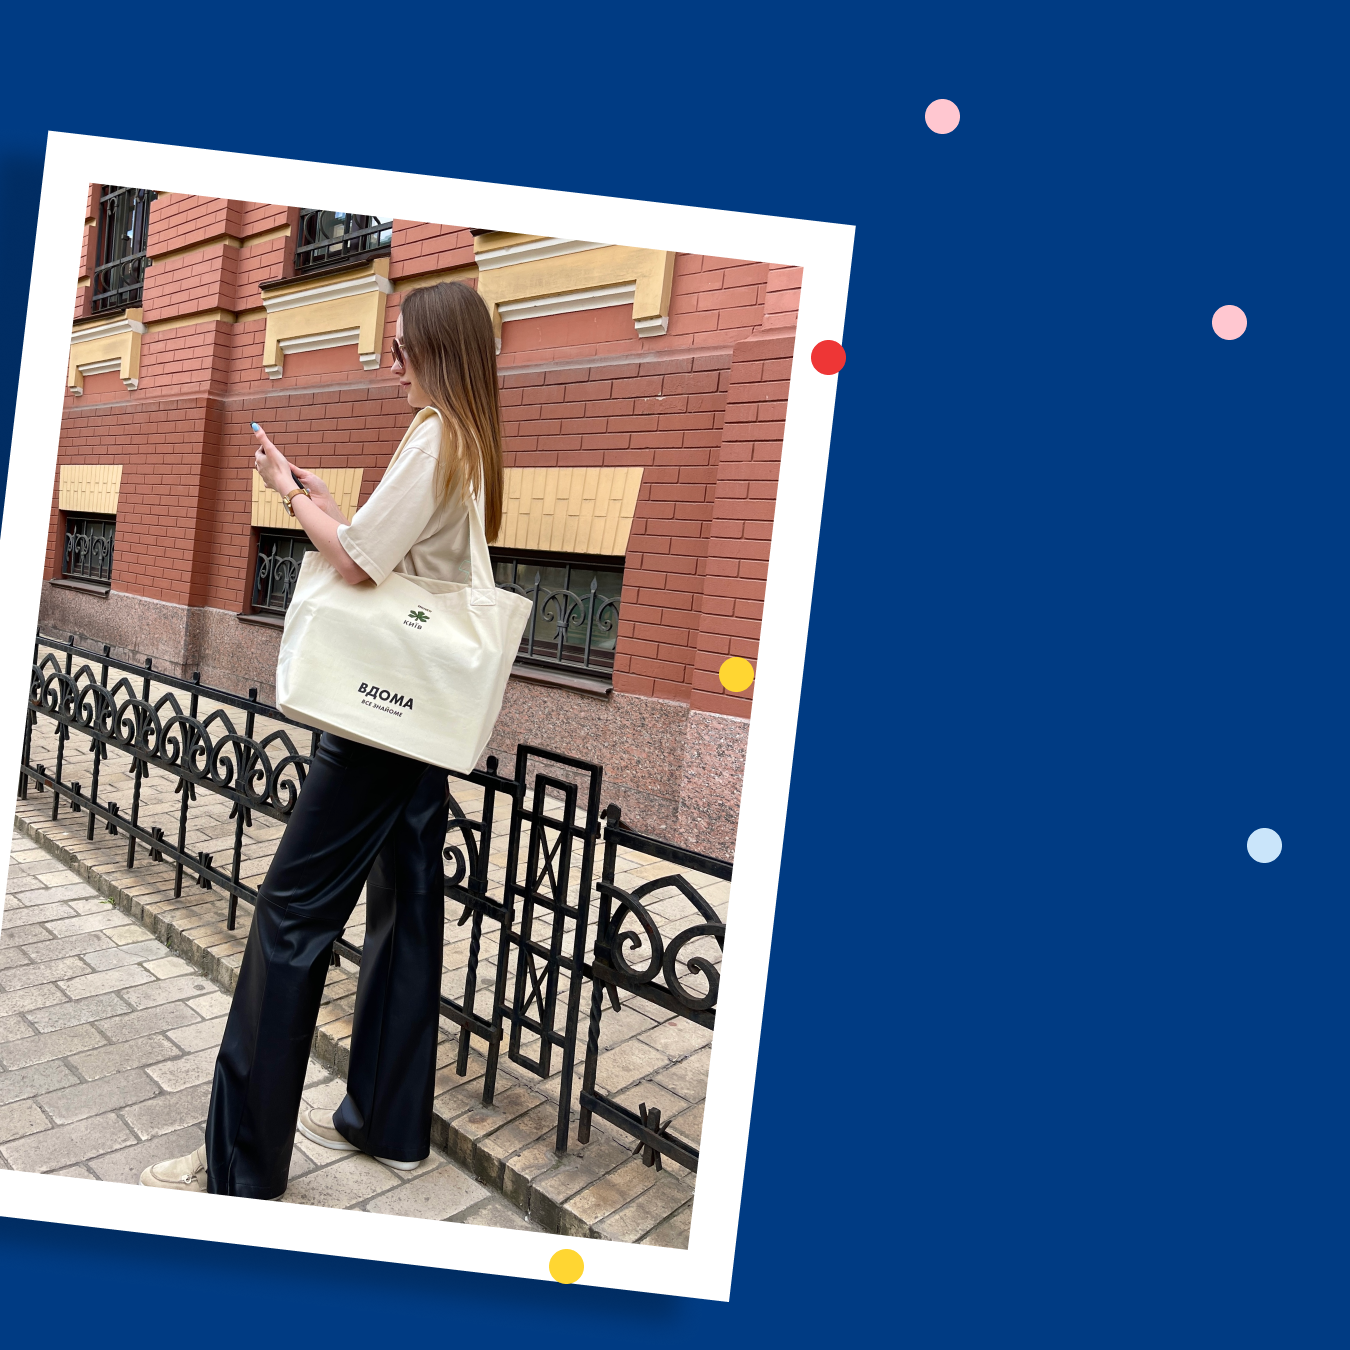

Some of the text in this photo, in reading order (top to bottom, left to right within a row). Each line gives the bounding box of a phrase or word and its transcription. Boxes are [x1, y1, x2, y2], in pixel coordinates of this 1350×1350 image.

[403, 619, 423, 630] КИЇВ
[357, 682, 414, 710] ВДОМА
[361, 699, 403, 717] ВСЕ ЗНАЙОМЕ
